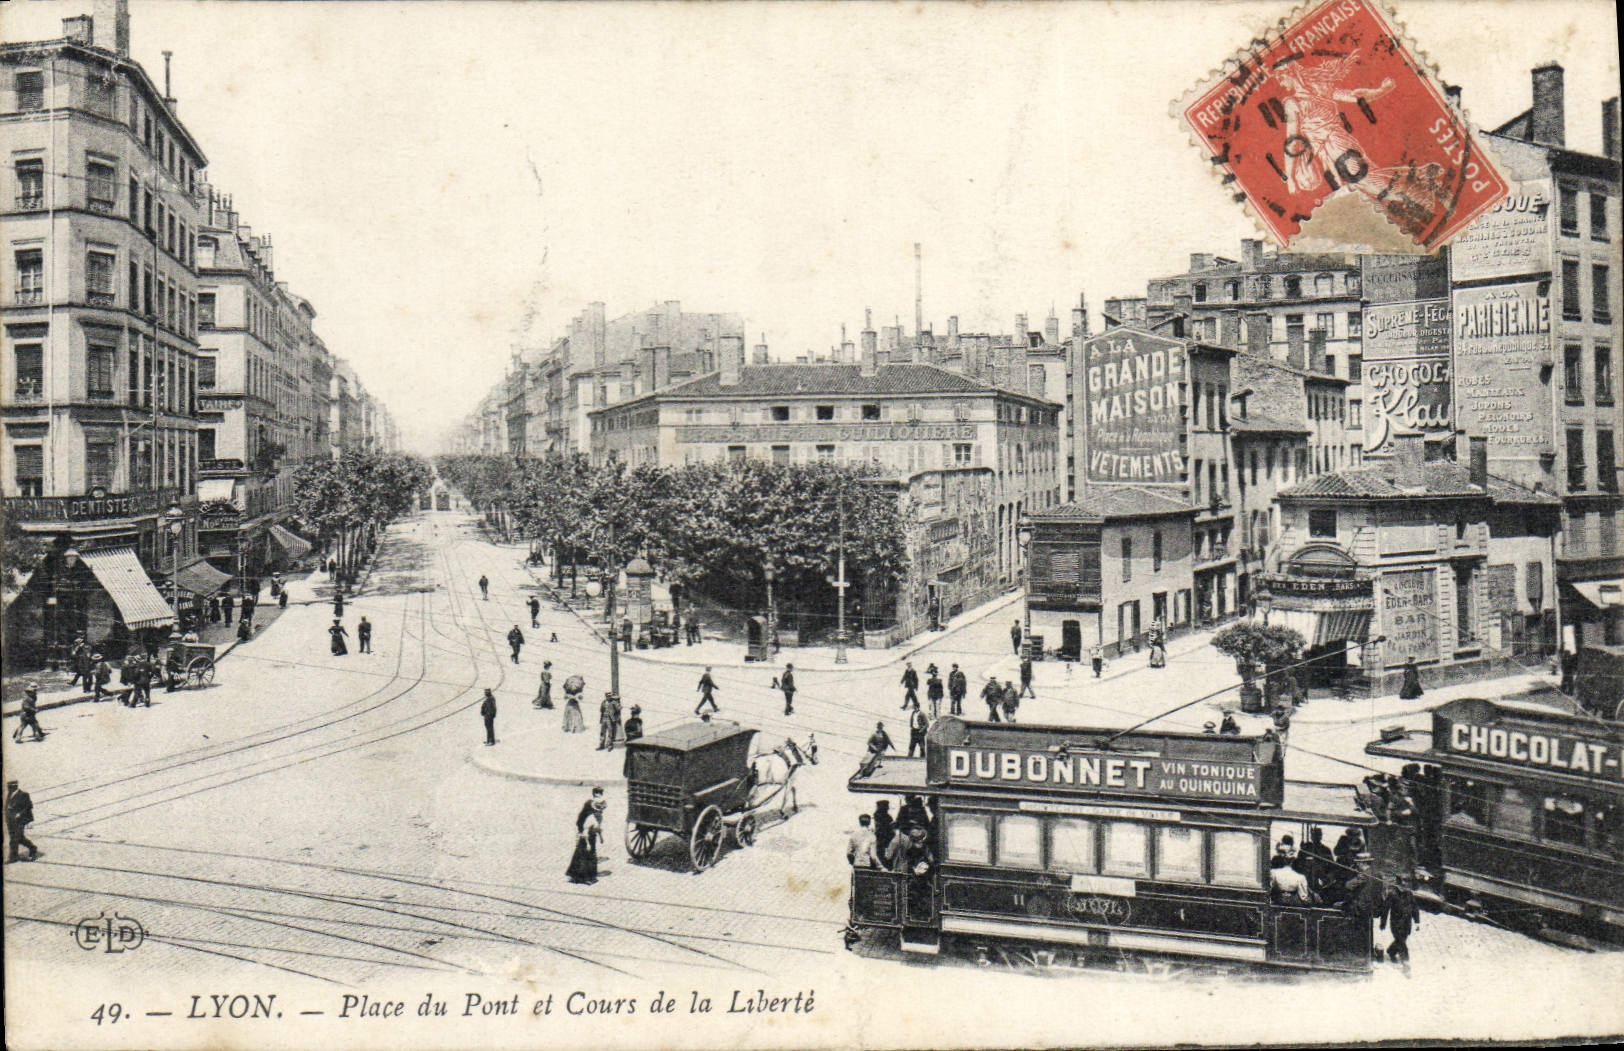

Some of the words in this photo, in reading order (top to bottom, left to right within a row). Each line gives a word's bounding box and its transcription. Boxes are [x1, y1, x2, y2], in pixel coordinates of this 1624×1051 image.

[1428, 118, 1491, 193] POSTES
[1457, 298, 1551, 340] PARISIENNE
[1107, 339, 1138, 354] LA
[1089, 346, 1182, 393] GRANDE
[1090, 381, 1181, 426] MAISON
[71, 498, 129, 516] DENTISTE
[1293, 582, 1326, 591] EDEN
[1394, 613, 1427, 626] BAR
[950, 749, 1151, 789] DUBONNET
[1160, 761, 1186, 777] VIN
[1191, 763, 1256, 780] TONIQUE
[1159, 778, 1174, 791] AU
[1179, 778, 1257, 797] QUINQUINA
